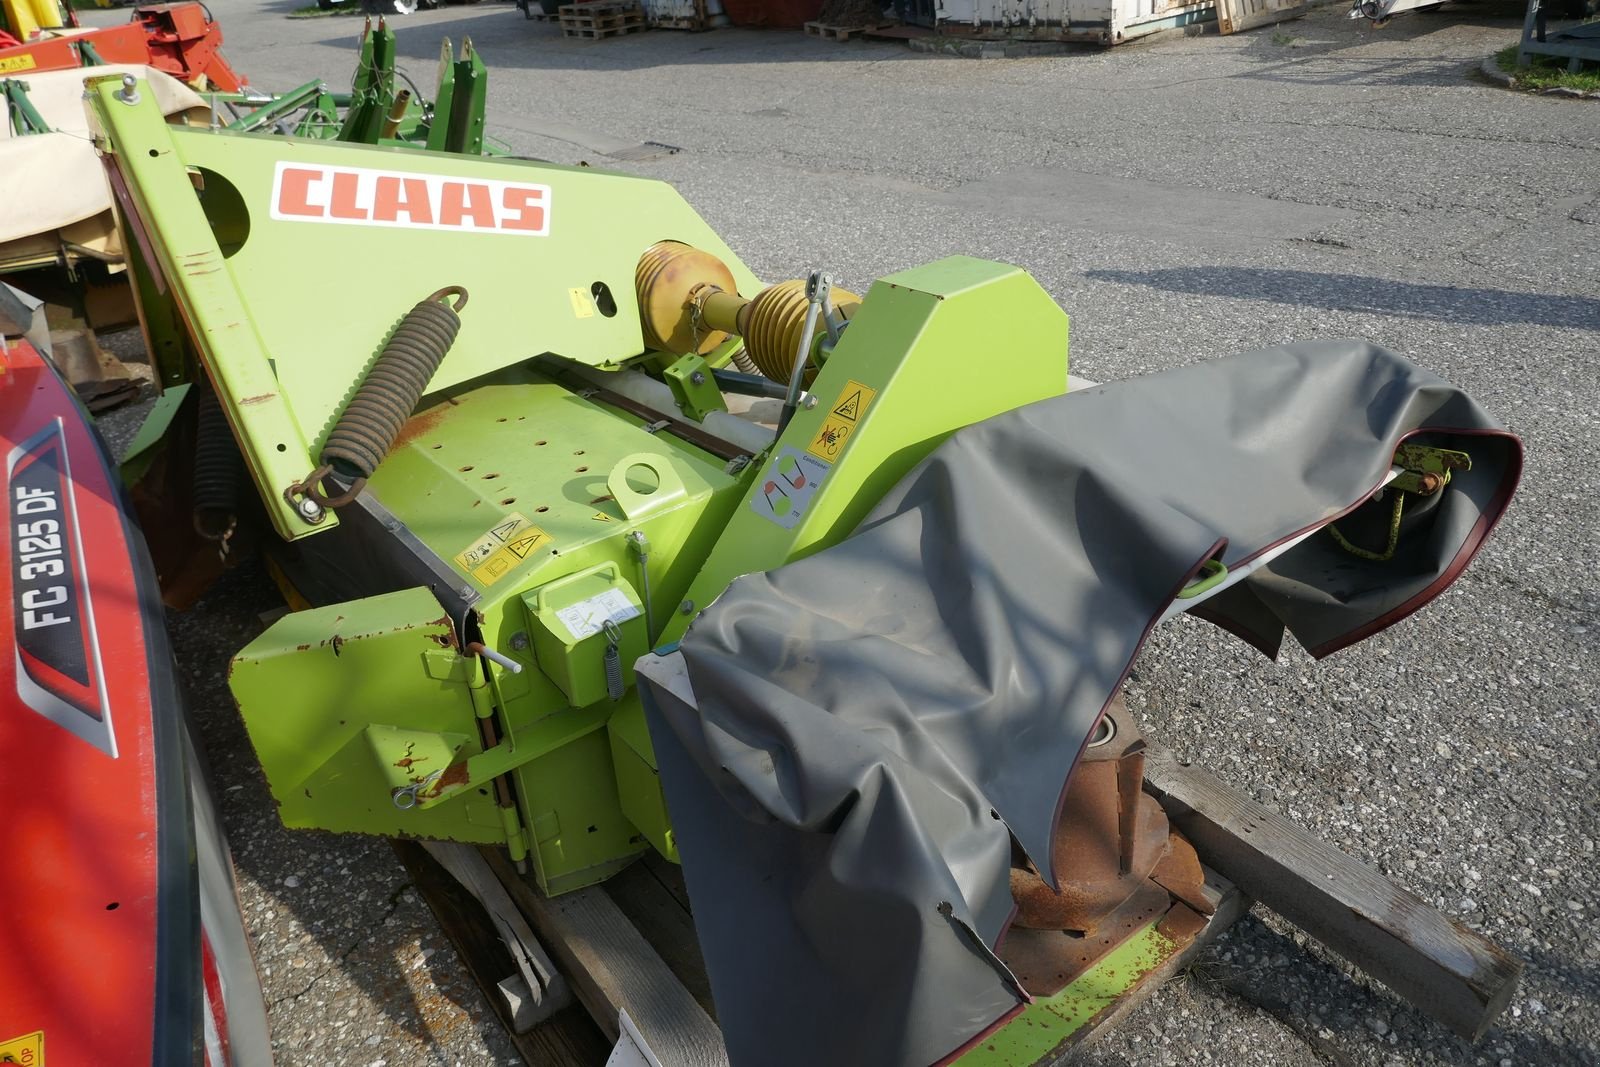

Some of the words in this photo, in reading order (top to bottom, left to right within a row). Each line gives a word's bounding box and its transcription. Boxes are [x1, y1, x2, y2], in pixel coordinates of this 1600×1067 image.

[278, 168, 544, 231] CLAAS
[802, 455, 828, 470] Conditioner
[16, 486, 57, 515] DF
[18, 519, 64, 580] 3125
[22, 585, 71, 630] FC
